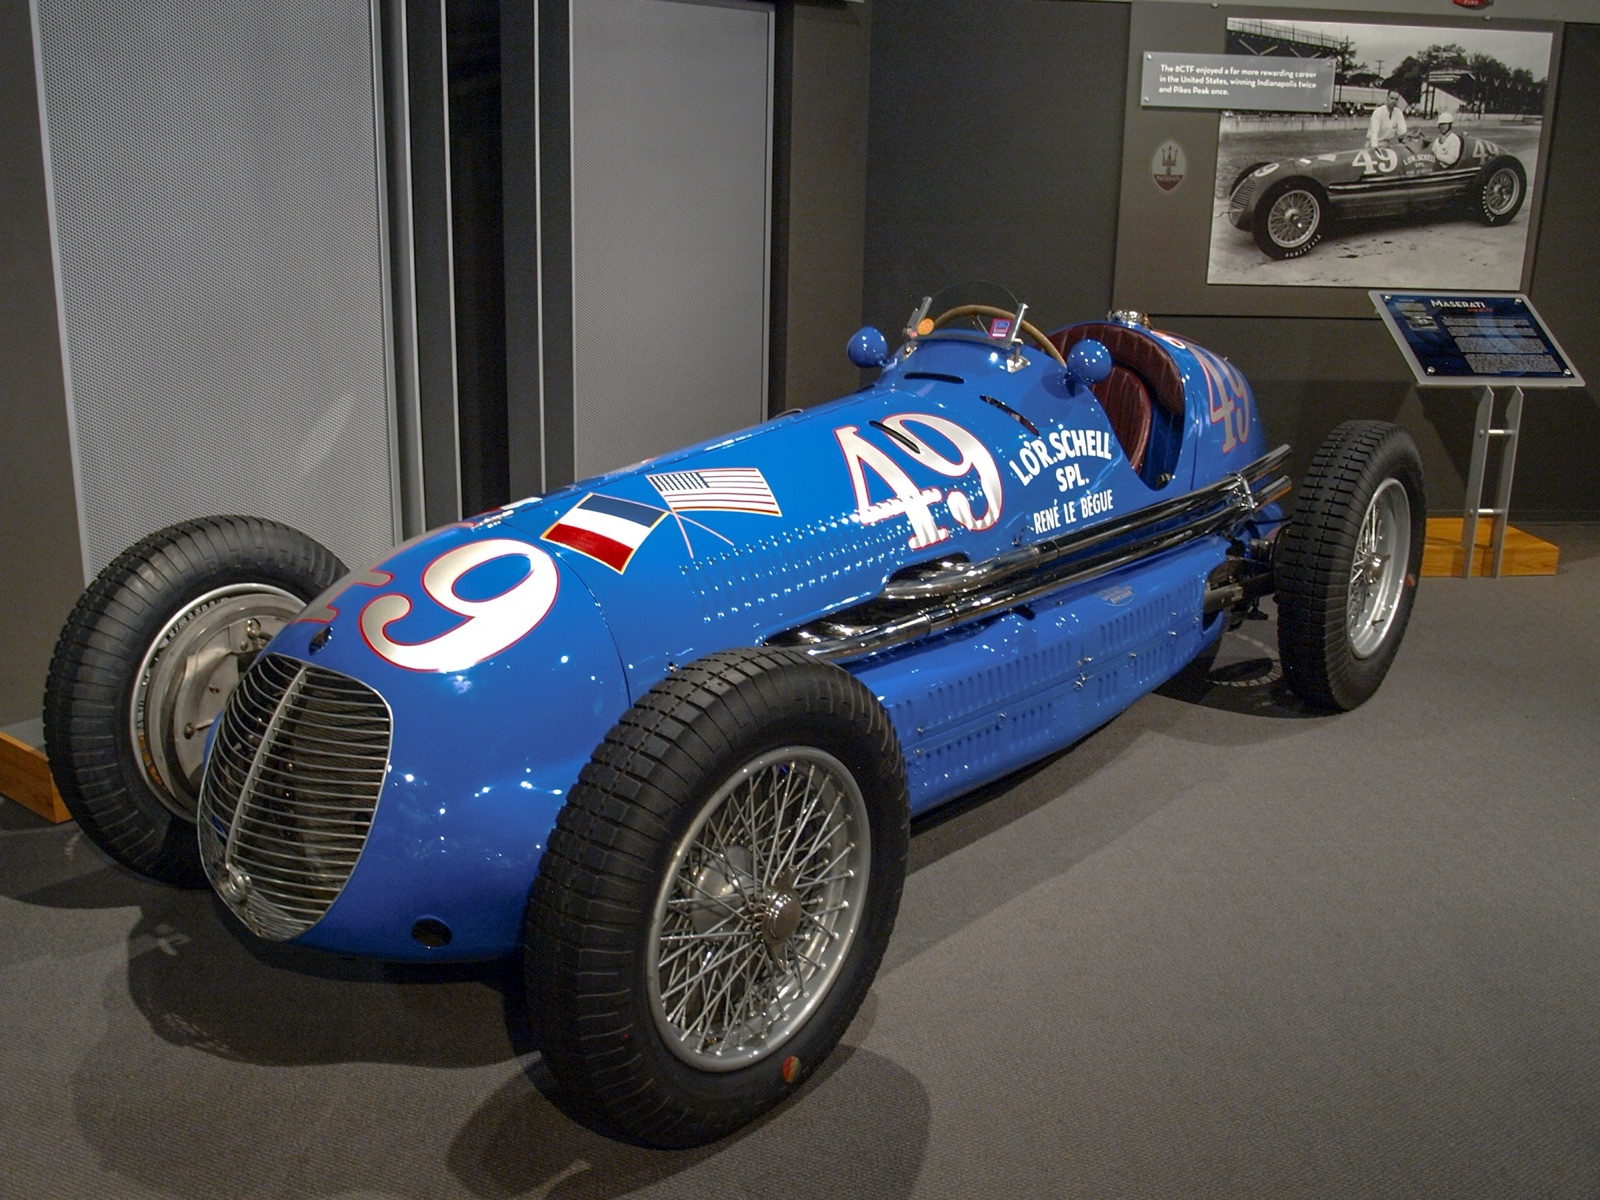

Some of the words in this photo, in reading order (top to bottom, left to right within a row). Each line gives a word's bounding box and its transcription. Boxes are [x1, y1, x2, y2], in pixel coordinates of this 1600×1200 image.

[1159, 75, 1166, 83] in
[1167, 75, 1179, 83] the
[1181, 76, 1205, 84] United
[1205, 77, 1229, 86] States,
[1230, 77, 1256, 88] winning
[1257, 79, 1297, 88] Indianapolis
[1298, 80, 1317, 88] twice
[1161, 64, 1174, 73] The
[1175, 65, 1195, 73] 8CTF
[1195, 66, 1224, 76] enjoyed
[1230, 66, 1240, 75] far
[1260, 69, 1294, 79] rewarding
[1158, 85, 1172, 93] and
[1173, 85, 1191, 94] Pikes
[1193, 86, 1209, 94] Peak
[1211, 88, 1230, 96] once.
[1352, 148, 1398, 175] 49
[1430, 299, 1486, 308] MASERATI
[1183, 340, 1250, 454] 49
[833, 412, 1003, 550] 49
[1055, 463, 1090, 492] SPL.
[1033, 498, 1061, 535] RENÉ
[1063, 501, 1077, 525] LE
